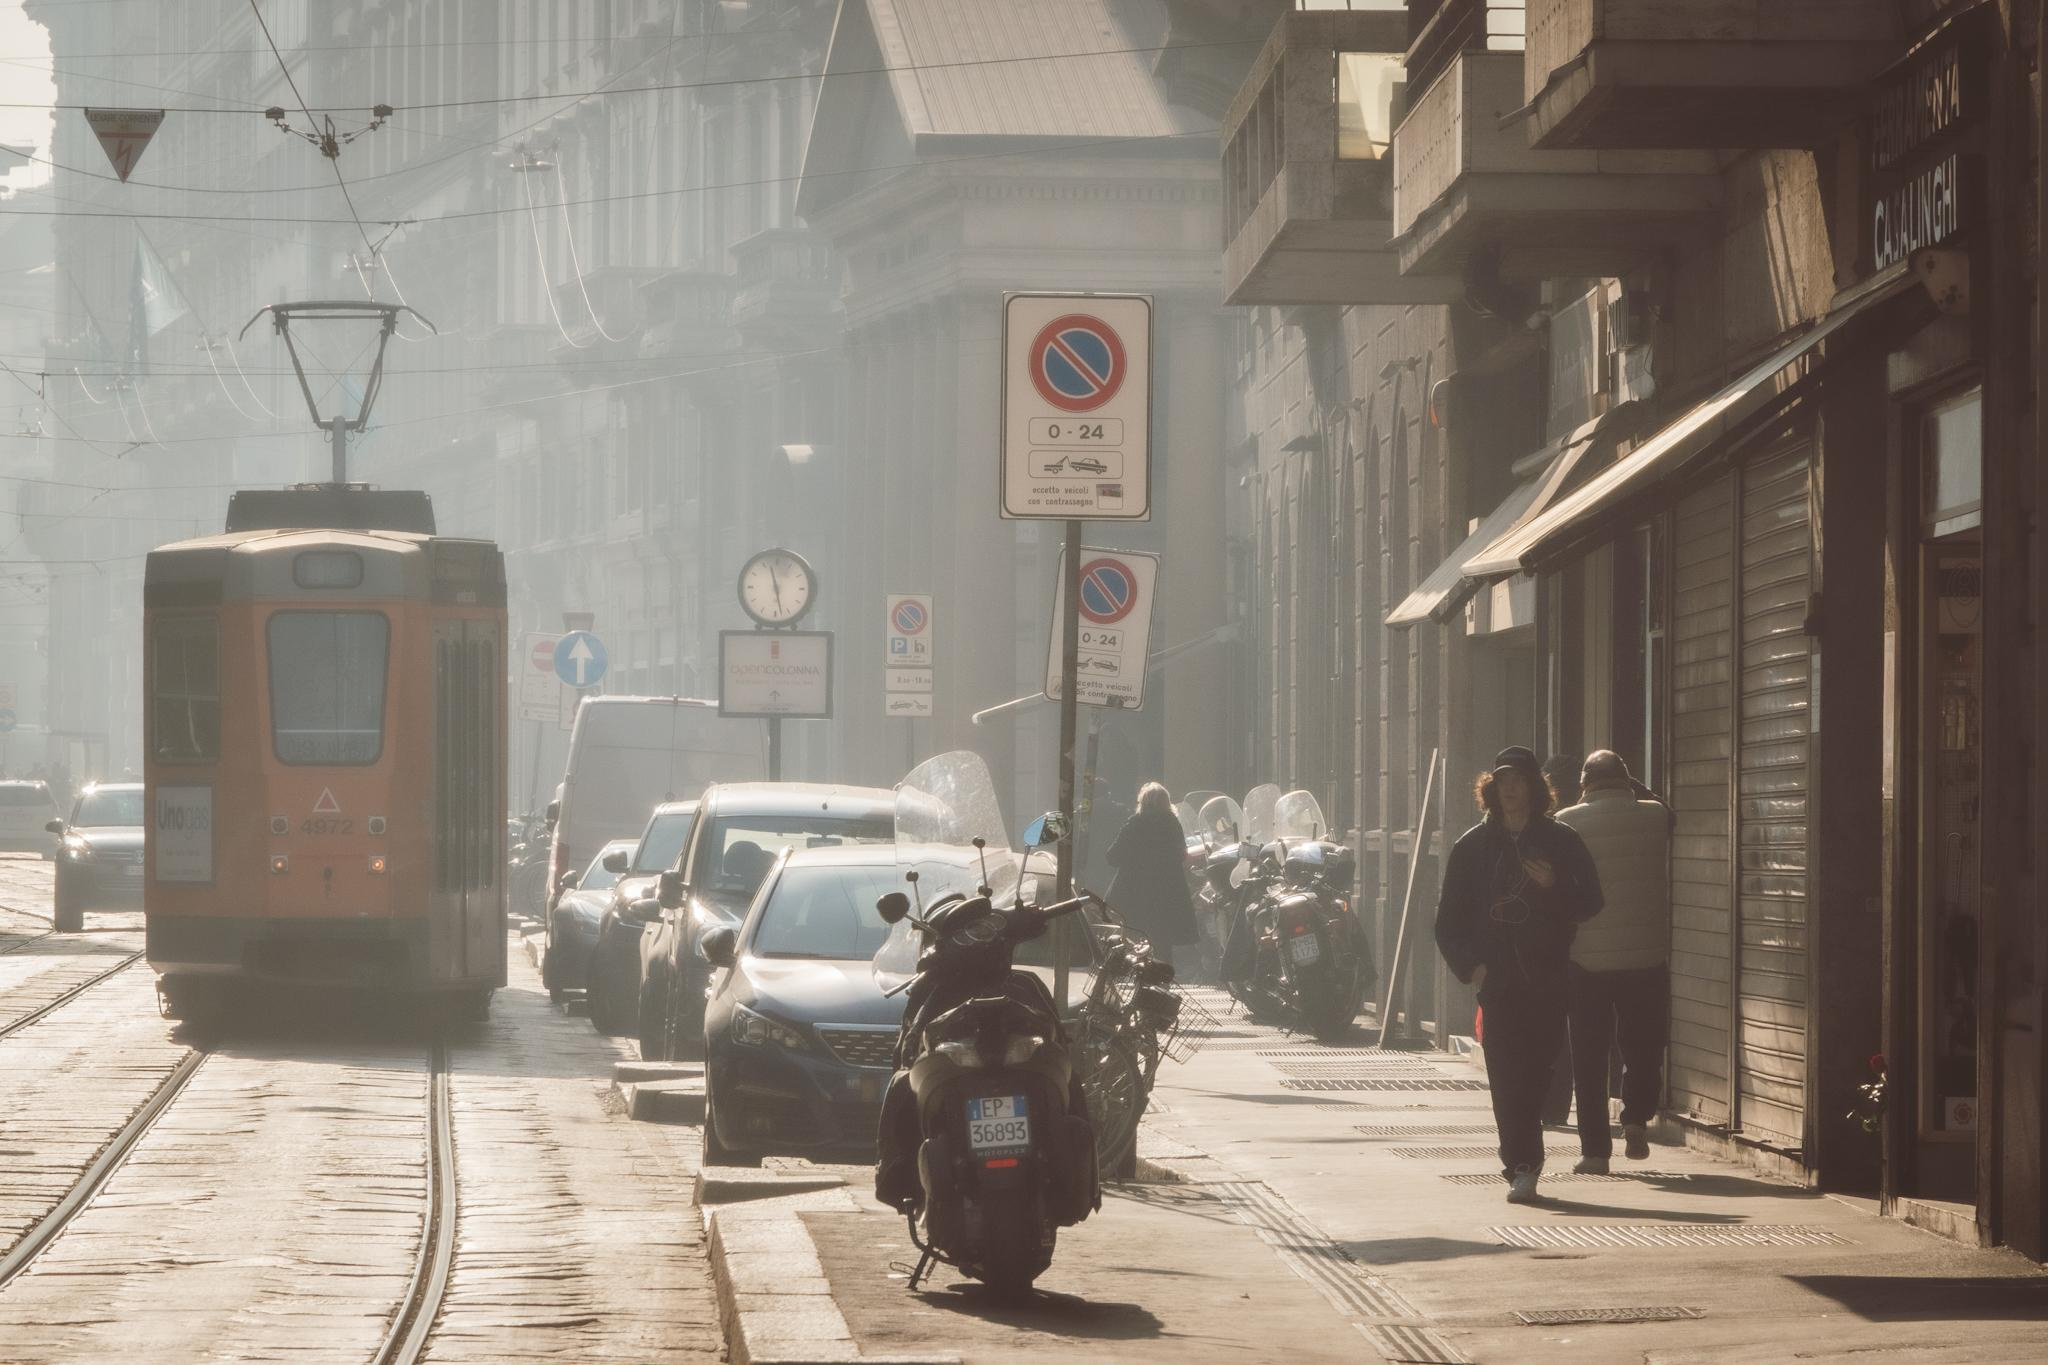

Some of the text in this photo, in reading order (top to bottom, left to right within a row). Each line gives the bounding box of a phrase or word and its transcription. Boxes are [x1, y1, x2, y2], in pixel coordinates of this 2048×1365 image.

[1874, 153, 1957, 271] CASALINGHI
[1048, 424, 1060, 439] 0
[1079, 424, 1104, 440] 24
[1032, 486, 1089, 494] eccetto veicoli
[1045, 498, 1093, 507] contrassegno
[1082, 632, 1091, 643] 0
[1099, 634, 1117, 646] 24
[1077, 680, 1133, 692] ccetto veicoli
[158, 800, 209, 840] Unogas
[301, 818, 353, 834] 4972
[982, 1099, 1003, 1118] EP
[972, 1121, 1026, 1143] 36893
